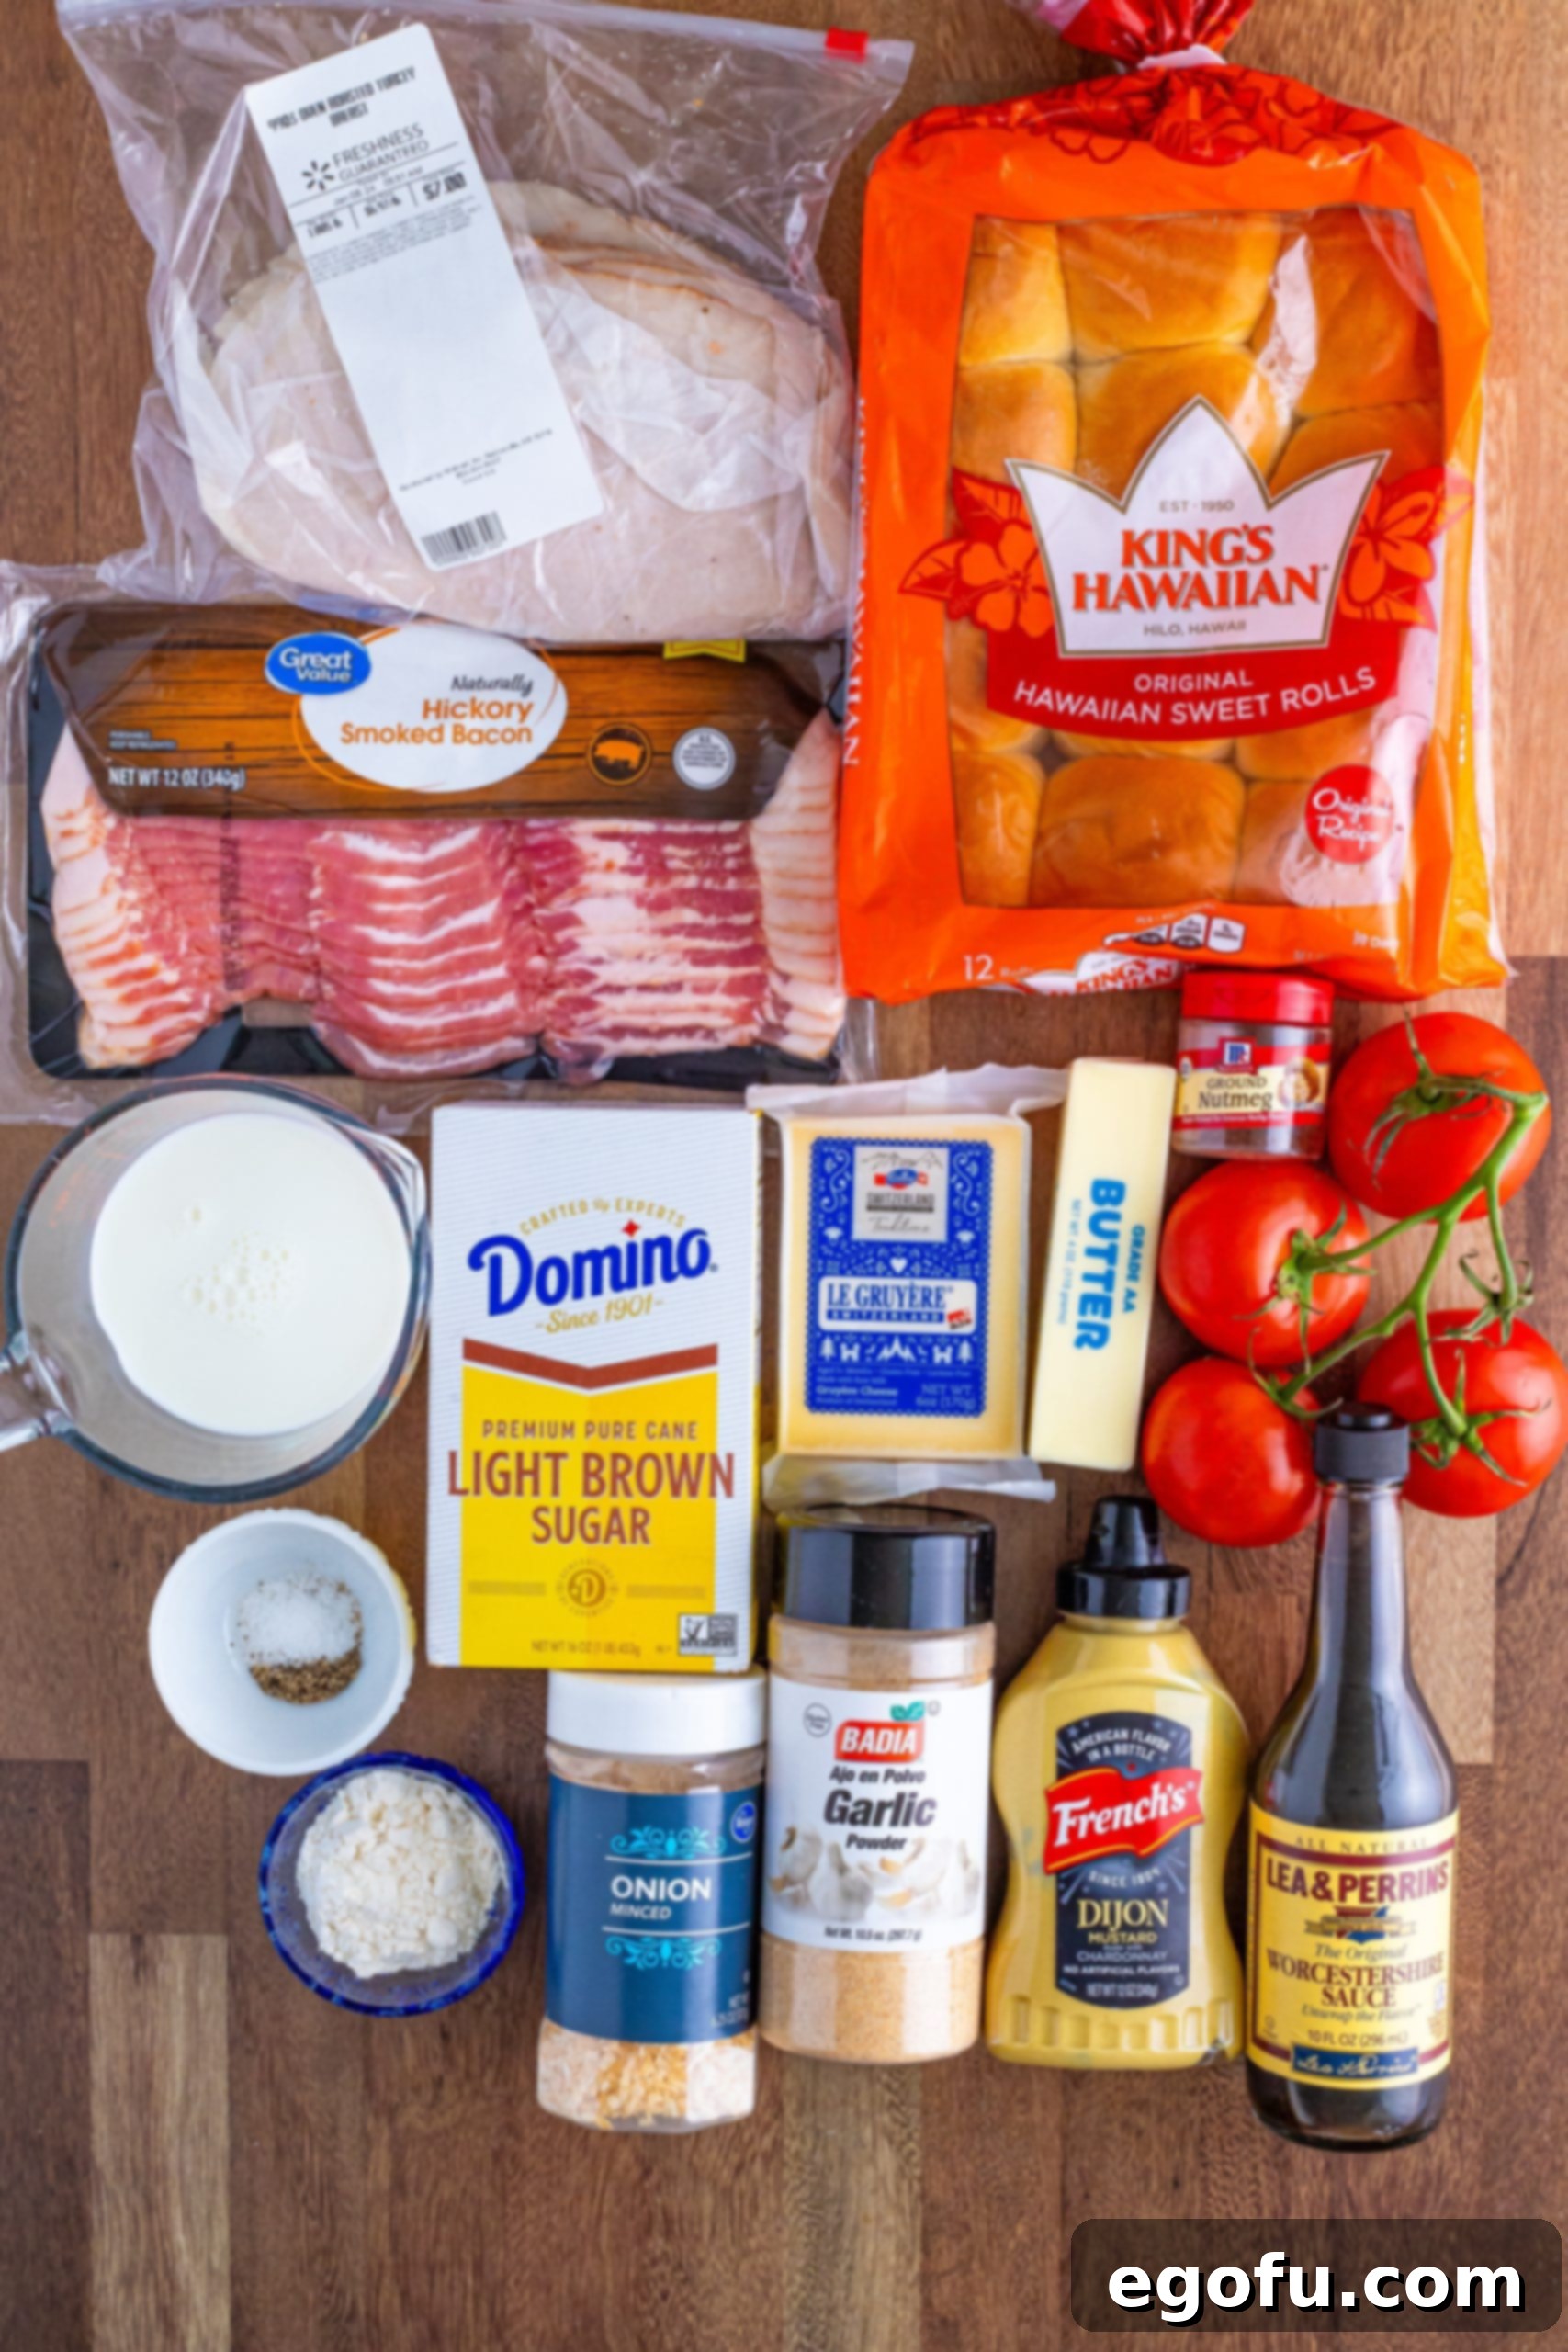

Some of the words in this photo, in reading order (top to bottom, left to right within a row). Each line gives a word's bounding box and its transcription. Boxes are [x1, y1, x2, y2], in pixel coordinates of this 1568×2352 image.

[332, 122, 424, 168] FRESHNESS
[339, 140, 430, 182] GUARANTEED
[1159, 500, 1190, 514] EST
[1201, 499, 1235, 513] 1950
[1121, 523, 1275, 569] KING'S
[1071, 564, 1321, 613] HAWAIIAN
[1143, 623, 1185, 638] HILO,
[1189, 620, 1247, 635] HAWAII
[279, 646, 353, 670] Great
[296, 666, 352, 684] Value
[450, 674, 534, 697] Naturally
[1134, 669, 1255, 694] ORIGINAL
[1013, 680, 1162, 725] HAWAIIAN
[1170, 692, 1272, 725] SWEET
[1280, 666, 1378, 711] ROLLS
[422, 696, 534, 723] Hickory
[340, 722, 446, 745] Smoked
[451, 722, 533, 745] Bacon
[108, 767, 135, 786] NET
[139, 767, 161, 786] WT
[164, 768, 178, 786] 12
[182, 768, 199, 786] OZ
[964, 954, 995, 981] 12
[1206, 1076, 1268, 1090] GROUND
[1198, 1090, 1273, 1112] Nutmeg
[519, 1198, 589, 1236] CRAFTED
[615, 1197, 686, 1229] EXPERTS
[1073, 1178, 1127, 1350] BUTTER
[1125, 1222, 1145, 1283] GRADE
[468, 1220, 711, 1317] Domino
[828, 1283, 851, 1306] LE
[1122, 1288, 1138, 1314] AA
[482, 1420, 575, 1440] PREMIUM
[584, 1420, 637, 1441] PURE
[645, 1421, 698, 1441] CANE
[447, 1450, 570, 1498] LIGHT
[581, 1452, 735, 1499] BROWN
[531, 1505, 651, 1546] SUGAR
[840, 1726, 918, 1754] BADIA
[1071, 1728, 1129, 1756] AMERICAN
[1132, 1728, 1172, 1754] FLAVOR
[1087, 1748, 1101, 1763] IN
[1103, 1745, 1111, 1758] A
[1113, 1743, 1156, 1763] BOTTLE
[829, 1765, 855, 1784] Ajo
[858, 1770, 879, 1784] en
[883, 1768, 926, 1785] Polvo
[823, 1789, 937, 1828] Garlic
[1053, 1780, 1188, 1848] French's
[845, 1833, 908, 1851] Powder
[1294, 1836, 1326, 1850] ALL
[1340, 1838, 1427, 1854] NATURAL
[610, 1875, 712, 1902] ONION
[1089, 1870, 1126, 1888] SINCE
[609, 1903, 672, 1920] MINCED
[1077, 1896, 1170, 1930] DIJON
[1088, 1931, 1158, 1945] MUSTARD
[1076, 1949, 1168, 1962] CHARDONNAY
[1314, 1942, 1342, 1958] The
[1345, 1943, 1407, 1963] Original
[1063, 1963, 1079, 1973] NO
[1081, 1964, 1134, 1974] ARTIFICIAL
[1137, 1964, 1181, 1975] FLAVORS
[1267, 1948, 1445, 1986] WORCESTERSHIRE
[1321, 1986, 1396, 2008] SAUCE
[1323, 2031, 1337, 2045] FL
[1338, 2032, 1358, 2046] OZ
